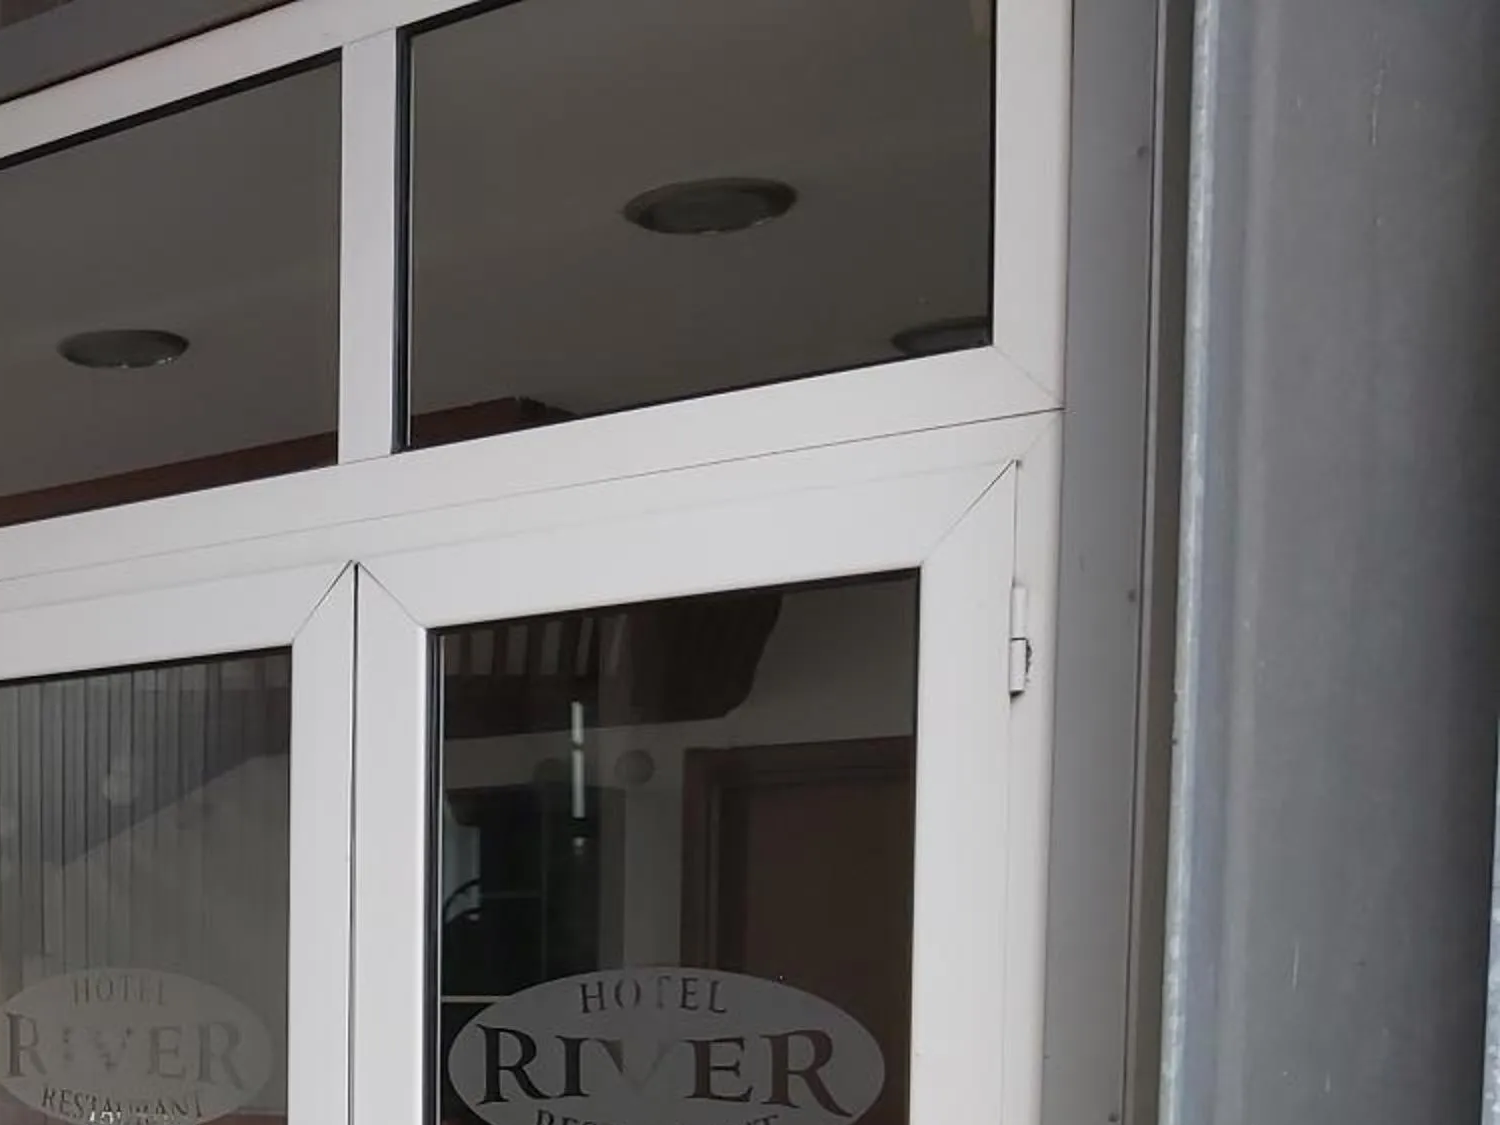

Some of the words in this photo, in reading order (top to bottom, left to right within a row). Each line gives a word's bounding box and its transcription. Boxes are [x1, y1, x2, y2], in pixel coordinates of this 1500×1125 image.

[71, 973, 166, 1006] HOTEL
[579, 975, 728, 1014] HOTEL
[475, 1022, 854, 1118] RIVER
